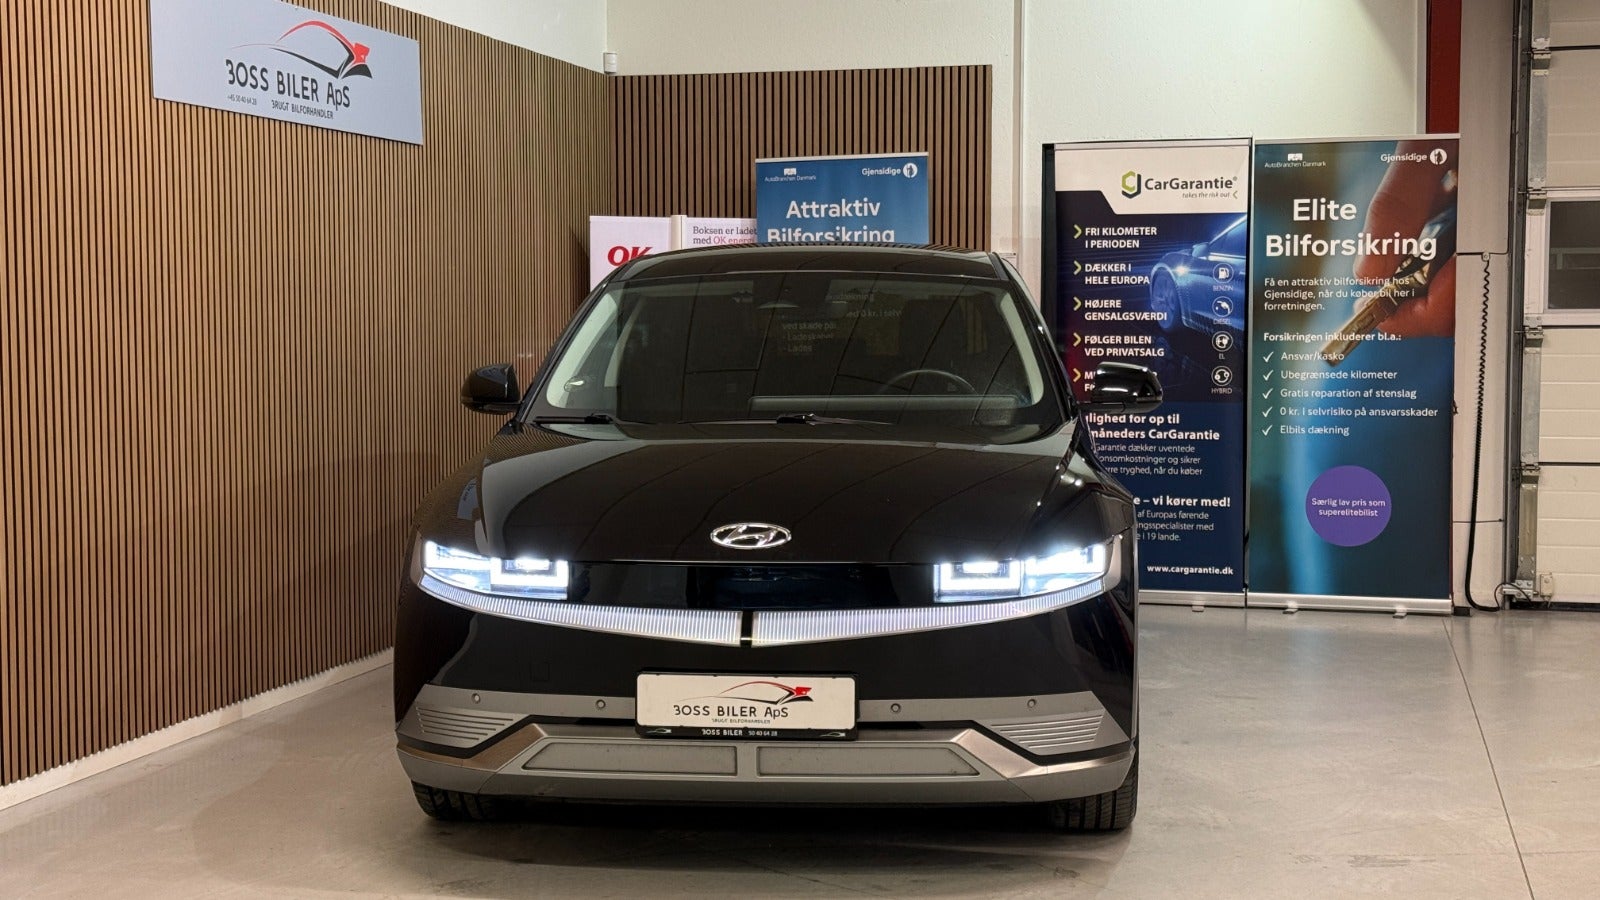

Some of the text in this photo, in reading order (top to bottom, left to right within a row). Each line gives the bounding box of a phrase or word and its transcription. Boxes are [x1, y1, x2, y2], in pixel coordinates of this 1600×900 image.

[276, 70, 320, 102] BILER
[326, 82, 350, 110] ApS
[292, 104, 334, 119] BILFORHANDLER
[1380, 153, 1427, 163] Gjensidige
[862, 166, 901, 177] Gjensidige
[786, 197, 880, 219] Attraktiv
[1293, 197, 1357, 221] Elite
[693, 226, 723, 235] Boksen
[736, 226, 757, 235] ladet
[767, 225, 895, 242] Bilforsikring
[1085, 226, 1157, 236] FRI KILOMETER
[693, 236, 711, 244] med
[714, 236, 726, 244] OK
[1085, 240, 1139, 249] I PERIODEN
[1266, 232, 1437, 260] Bilforsikring
[607, 246, 653, 267] OK
[1085, 263, 1131, 272] DÆKKER I
[1085, 276, 1150, 284] HELE EUROPA
[1264, 277, 1275, 286] Få
[1291, 278, 1331, 286] attraktiv
[1334, 277, 1390, 287] bilforsikring
[1264, 289, 1316, 299] Gjensidige,
[1318, 289, 1332, 298] når
[1336, 289, 1348, 297] du
[1380, 289, 1391, 297] bil
[1085, 299, 1122, 308] HØJERE
[1264, 301, 1325, 312] forretningen.
[1085, 312, 1167, 321] GENSALGSVÆRDI
[1085, 335, 1152, 344] FØLGER BILEN
[1264, 332, 1402, 343] Forsikringen inkluderer bl.a.:
[1085, 348, 1164, 357] VED PRIVATSALG
[1281, 352, 1344, 361] Ansvar/kasko
[1281, 370, 1397, 381] Ubegrænsede kilometer
[1280, 388, 1416, 400] Gratis reparation af stenslag
[1280, 408, 1286, 416] 0
[1289, 408, 1300, 416] kr.
[1308, 408, 1352, 416] selvrisiko
[1355, 408, 1366, 418] på
[1369, 408, 1438, 417] ansvarsskader
[1086, 413, 1180, 426] lighed for op til
[1091, 429, 1220, 440] måneders CarGarantie
[1280, 425, 1349, 436] Elbils dækning
[1158, 444, 1195, 452] uventede
[1120, 466, 1152, 475] tryghed,
[1152, 496, 1163, 505] vi
[1166, 496, 1198, 506] kører
[1201, 497, 1230, 507] med!
[1311, 498, 1338, 507] Særlig
[1352, 499, 1367, 508] pris
[1147, 511, 1177, 520] Europas
[1319, 509, 1378, 518] superelitebilist
[1196, 523, 1214, 531] med
[1157, 533, 1181, 541] lande.
[1147, 565, 1234, 575] www.cargarantie.dk
[718, 706, 756, 717] BILER
[764, 707, 789, 719] ApS
